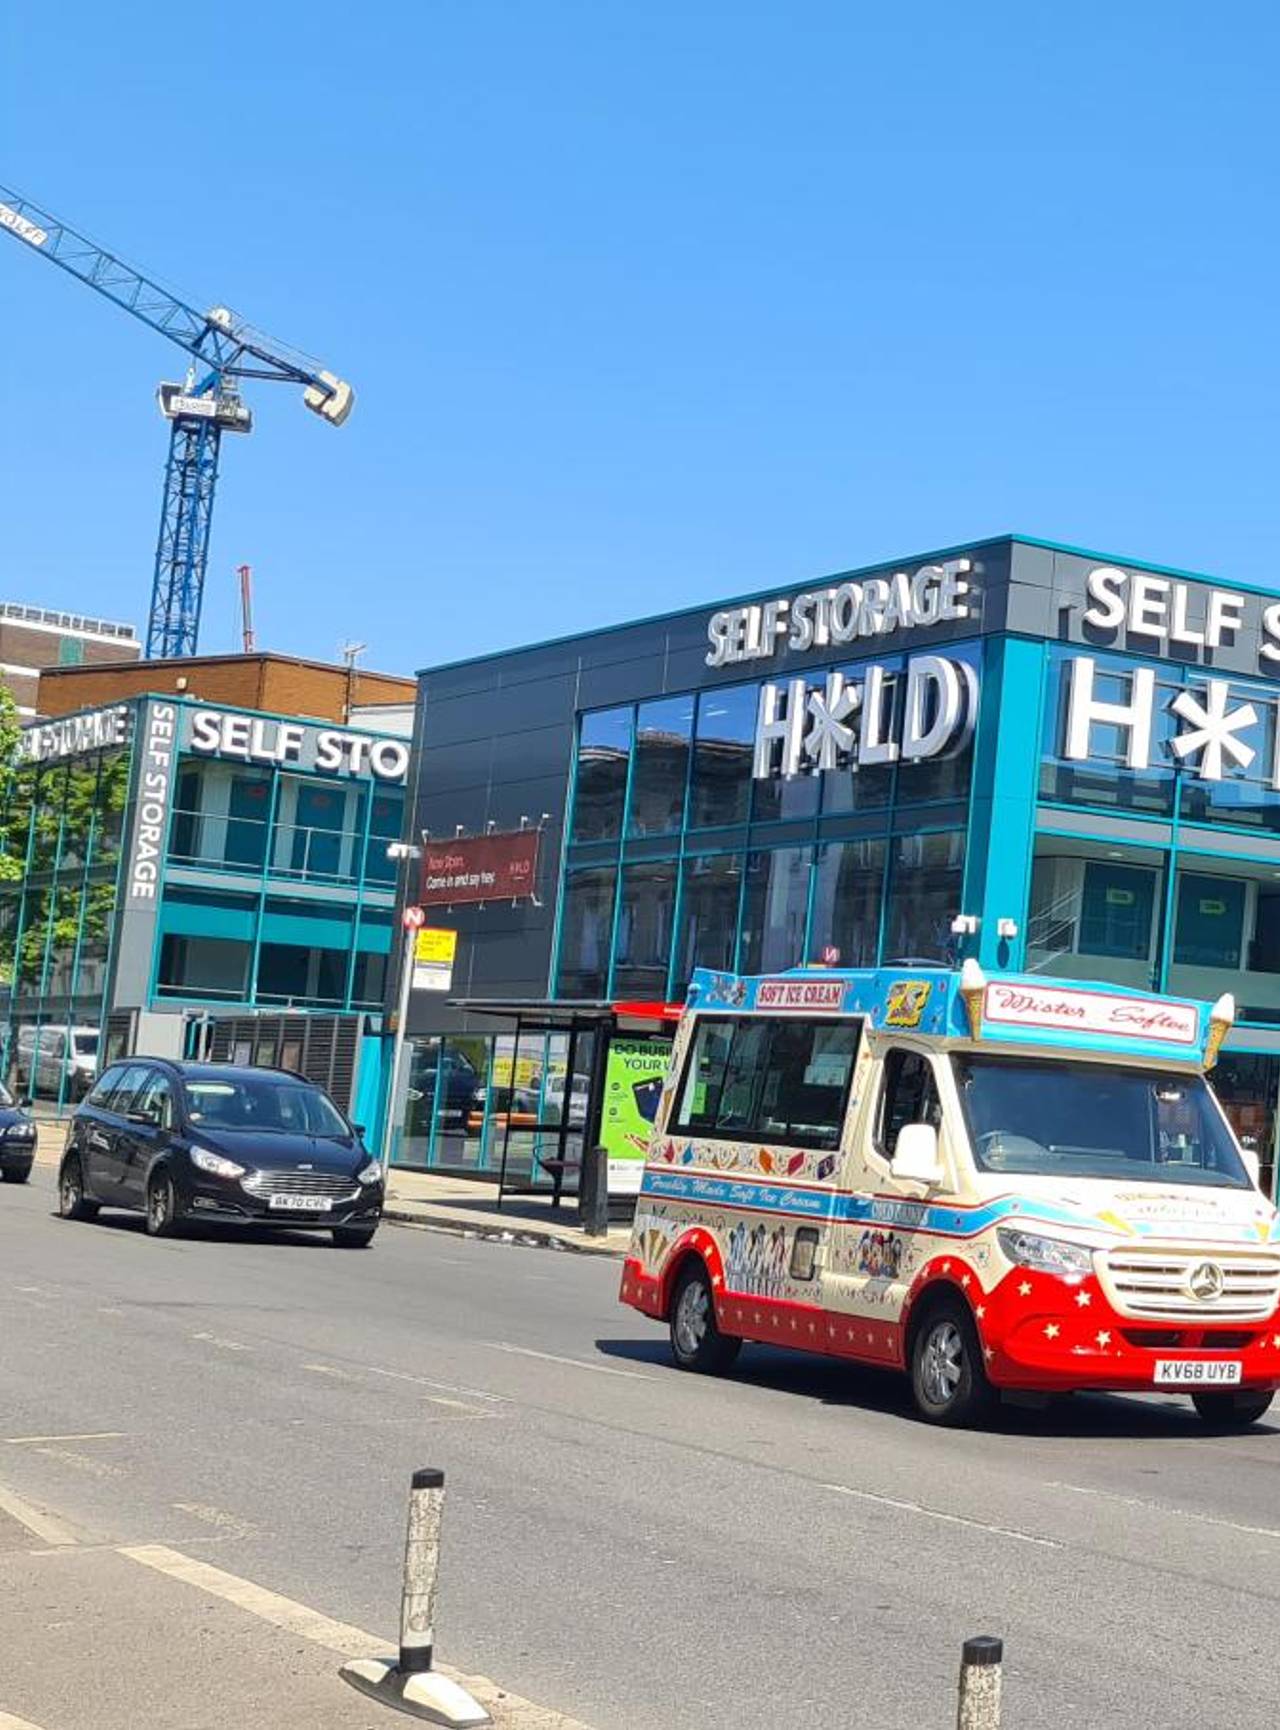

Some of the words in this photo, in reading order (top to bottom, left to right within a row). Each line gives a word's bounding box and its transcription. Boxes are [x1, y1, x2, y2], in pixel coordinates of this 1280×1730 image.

[706, 599, 789, 667] SELF
[788, 559, 971, 651] STORAGE
[1083, 566, 1245, 648] SELF
[147, 704, 175, 773] SELF
[191, 712, 305, 762] SELF
[314, 731, 410, 778] STO
[131, 773, 168, 899] STORAGE
[760, 984, 785, 1003] SOFT
[786, 985, 802, 1003] ICE
[803, 985, 842, 1004] CREAM
[995, 988, 1087, 1019] Mister
[1108, 1005, 1192, 1032] Softee
[623, 1058, 662, 1071] YOUR
[639, 1044, 673, 1057] BUSI
[1161, 1363, 1204, 1380] KV68
[1207, 1363, 1238, 1380] UYB
